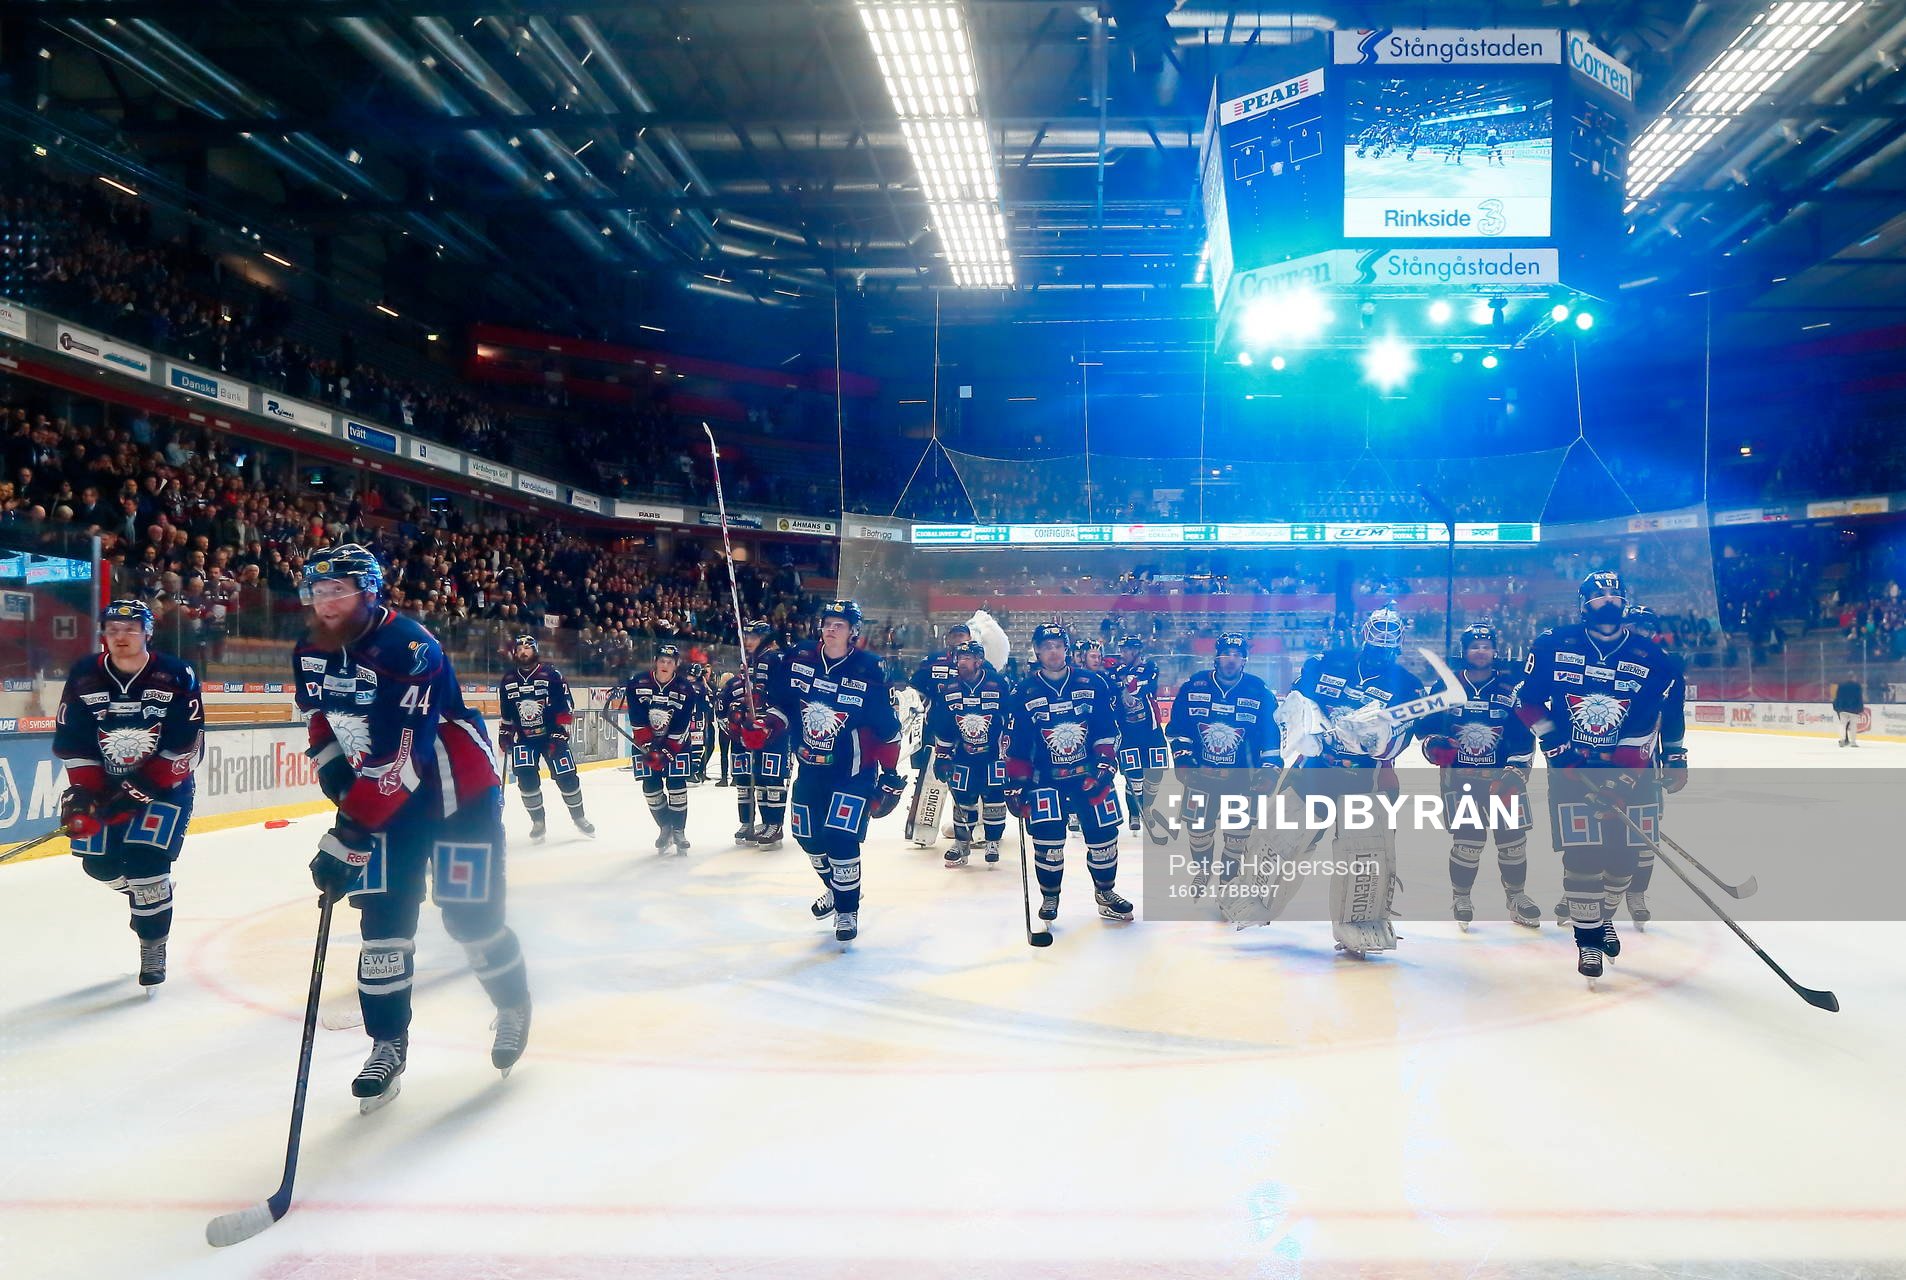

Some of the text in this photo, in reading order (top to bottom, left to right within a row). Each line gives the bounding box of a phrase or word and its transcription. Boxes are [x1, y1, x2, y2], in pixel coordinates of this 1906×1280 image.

[1390, 34, 1543, 62] Stångåstaden
[1571, 38, 1631, 97] Corren
[1242, 82, 1299, 114] PEAB
[1384, 209, 1471, 227] Rinkside
[1388, 252, 1540, 282] Stångåstaden
[181, 375, 241, 402] Danske Bank
[349, 424, 367, 440] tvätt
[520, 479, 554, 497] Handelsbanken
[638, 511, 661, 519] PARS
[1034, 528, 1076, 538] CONFIGURA
[1339, 529, 1385, 537] CCM
[188, 698, 201, 721] 2
[399, 685, 432, 716] 44
[1389, 695, 1445, 720] CCM
[29, 719, 56, 729] SYNSAM
[121, 780, 155, 804] CCM
[924, 788, 941, 827] LEGENDS
[835, 866, 858, 875] EWG
[1571, 902, 1597, 911] EWG
[362, 952, 399, 965] EWG
